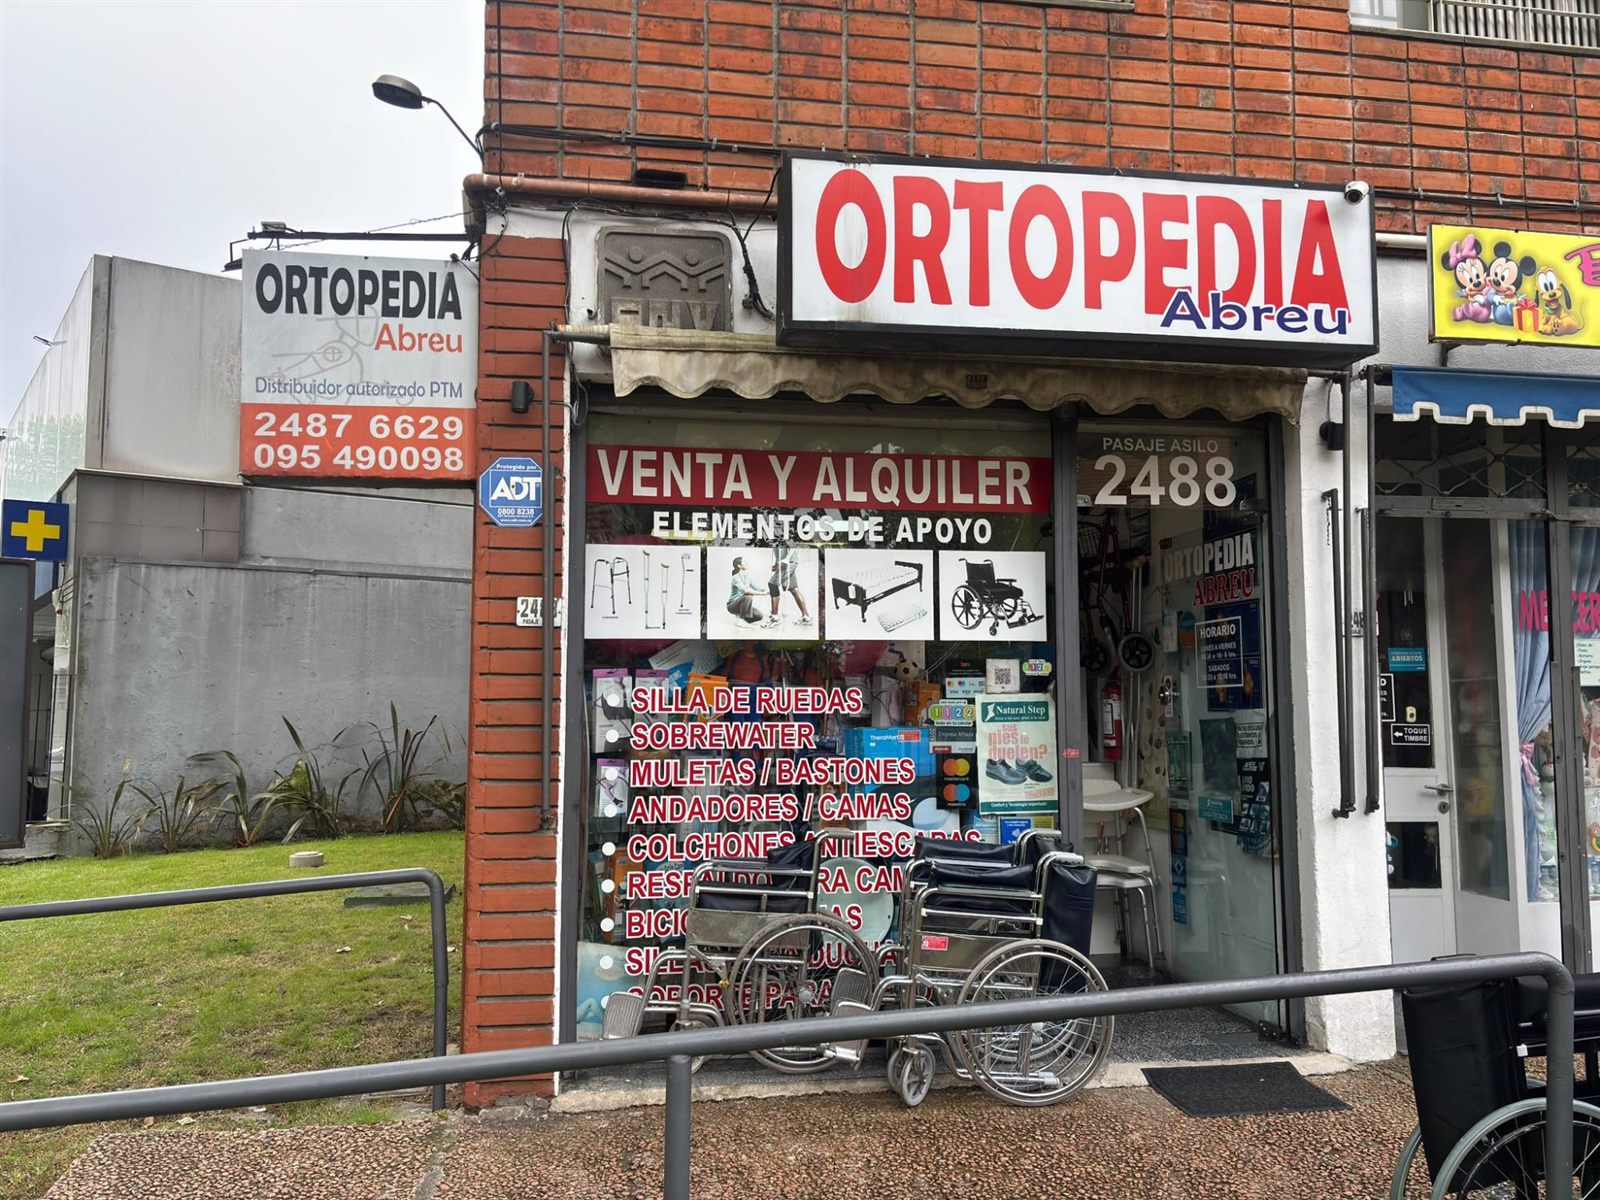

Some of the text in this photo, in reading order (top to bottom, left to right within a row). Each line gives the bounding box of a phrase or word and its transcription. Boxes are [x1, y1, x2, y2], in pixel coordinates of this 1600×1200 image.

[815, 168, 1351, 323] ORTOPEDIA
[255, 263, 462, 320] ORTOPEDIA
[1160, 291, 1349, 335] Abreu
[374, 323, 463, 353] Abreu
[255, 377, 463, 398] Distribuidor autorizado PTM
[255, 412, 464, 440] 2487 6629
[254, 444, 464, 471] 095 490098
[1103, 437, 1218, 453] PASAJE ASILO
[491, 477, 542, 501] ADT
[597, 449, 1032, 507] VENTA Y ALQUILER
[1094, 454, 1237, 507] 2488
[653, 511, 992, 544] ELEMENTOS DE APOYO
[1165, 532, 1254, 582] ORTOPEDIA
[1193, 567, 1255, 605] ABREU
[1200, 624, 1235, 638] HORARIO
[632, 686, 863, 714] SILLA DE RUEDAS
[935, 707, 973, 718] 1122
[996, 704, 1046, 715] Natural Step
[631, 722, 816, 750] SOBREWATER
[988, 731, 1018, 746] pies
[988, 744, 1048, 760] duelen?
[631, 757, 916, 786] MULETAS / BASTONES
[627, 793, 911, 824] ANDADORES / CAMAS
